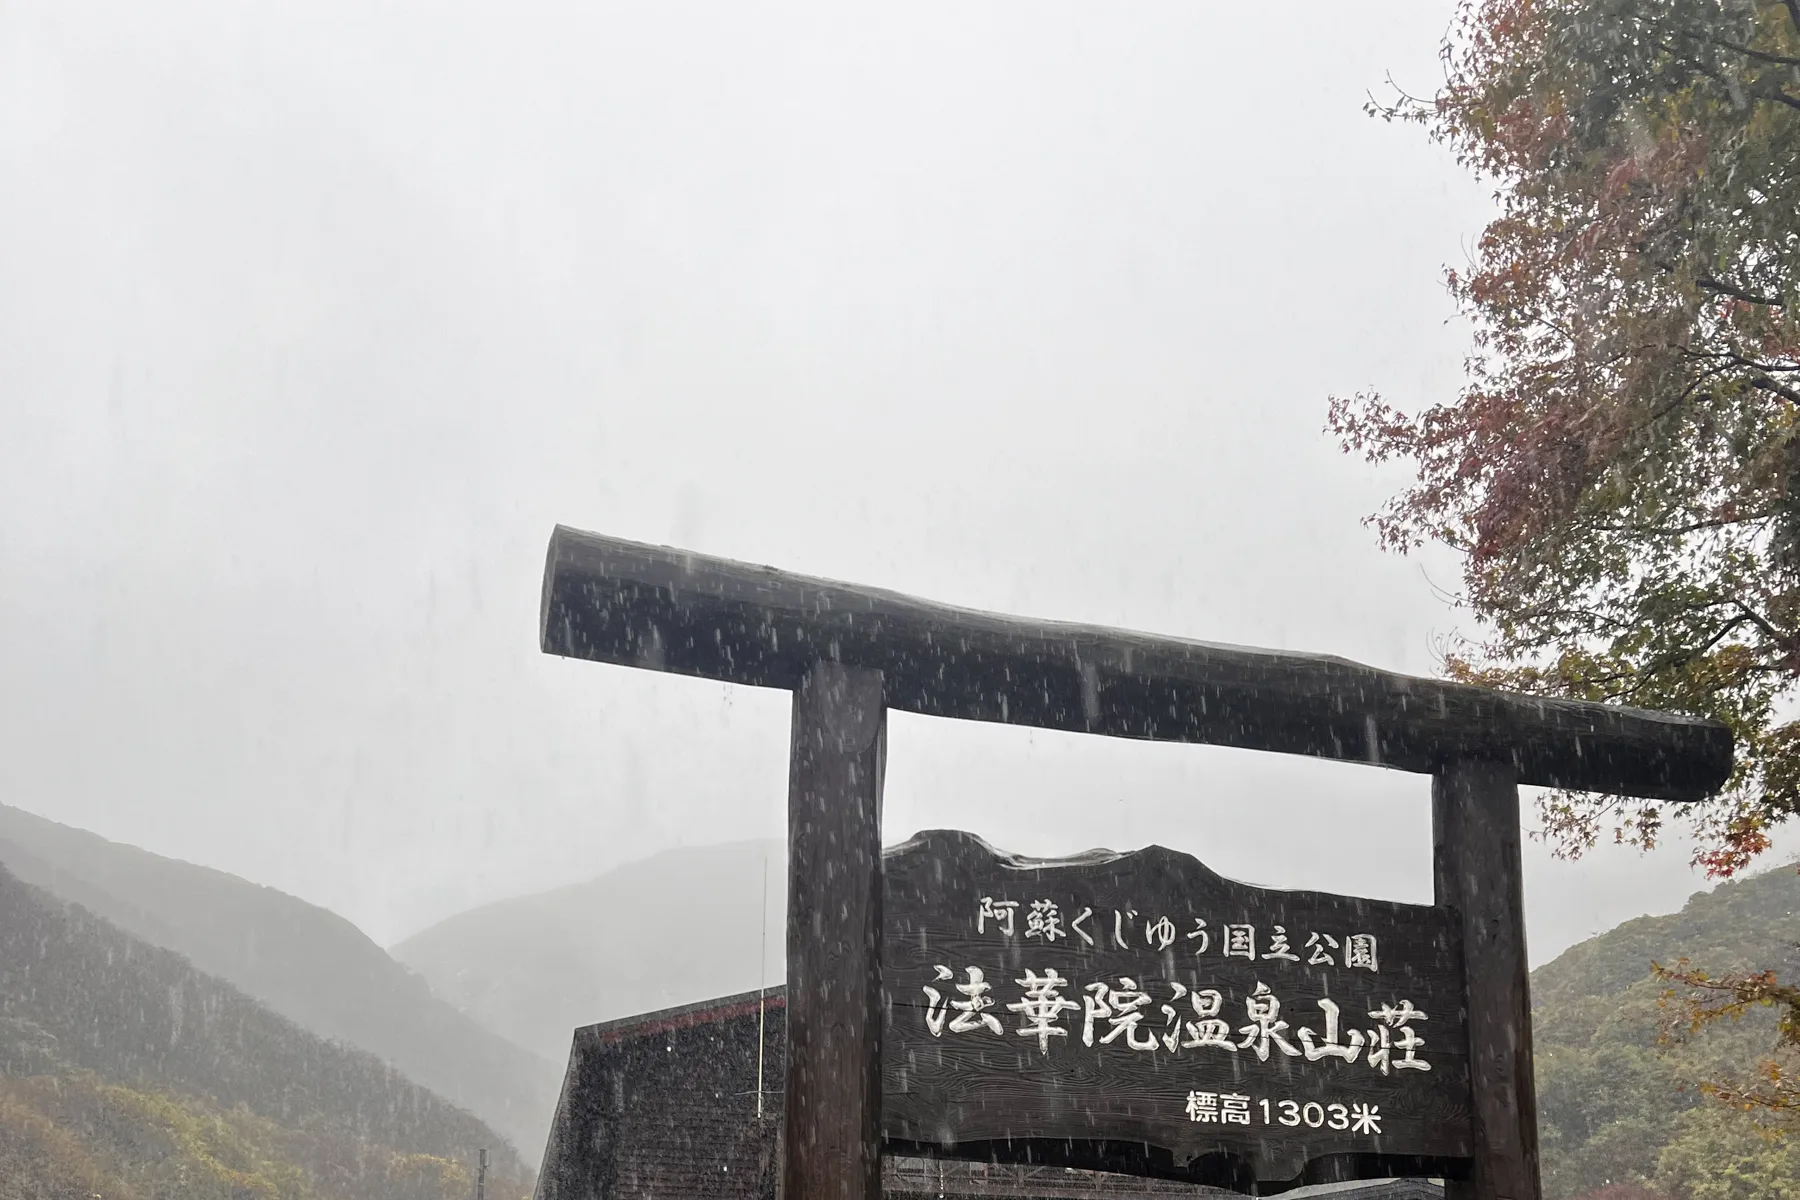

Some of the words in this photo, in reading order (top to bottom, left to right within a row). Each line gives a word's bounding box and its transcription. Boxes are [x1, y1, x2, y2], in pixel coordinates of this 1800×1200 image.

[922, 965, 1432, 1076] 法華院温泉山荘
[1185, 1090, 1382, 1135] 標高1303米
